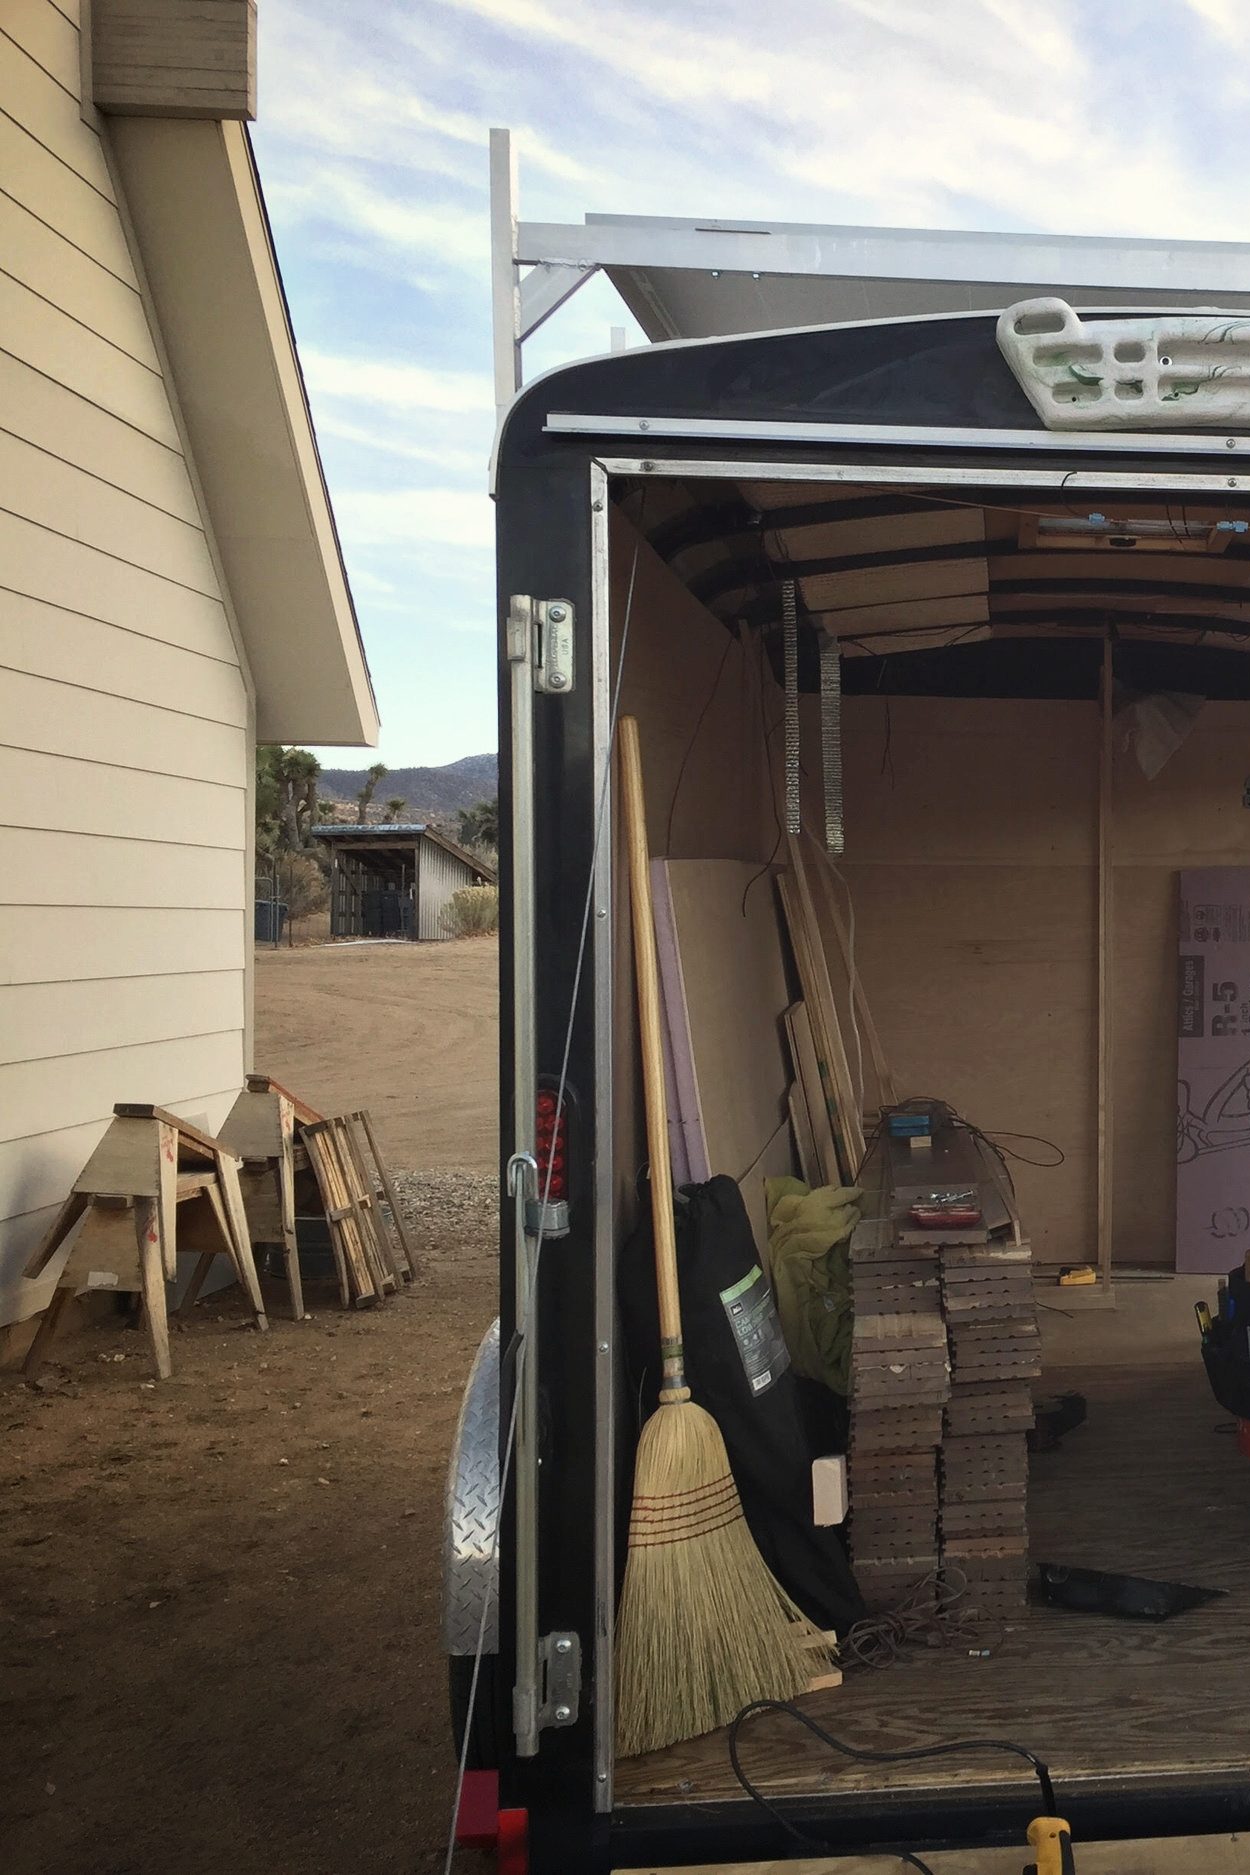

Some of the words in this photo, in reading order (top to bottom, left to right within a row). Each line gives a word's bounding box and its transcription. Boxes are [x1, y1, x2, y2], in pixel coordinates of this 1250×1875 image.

[1182, 960, 1196, 997] Garages
[1182, 1006, 1194, 1031] Attics
[1211, 981, 1238, 1037] R-5
[1240, 1002, 1248, 1023] inch
